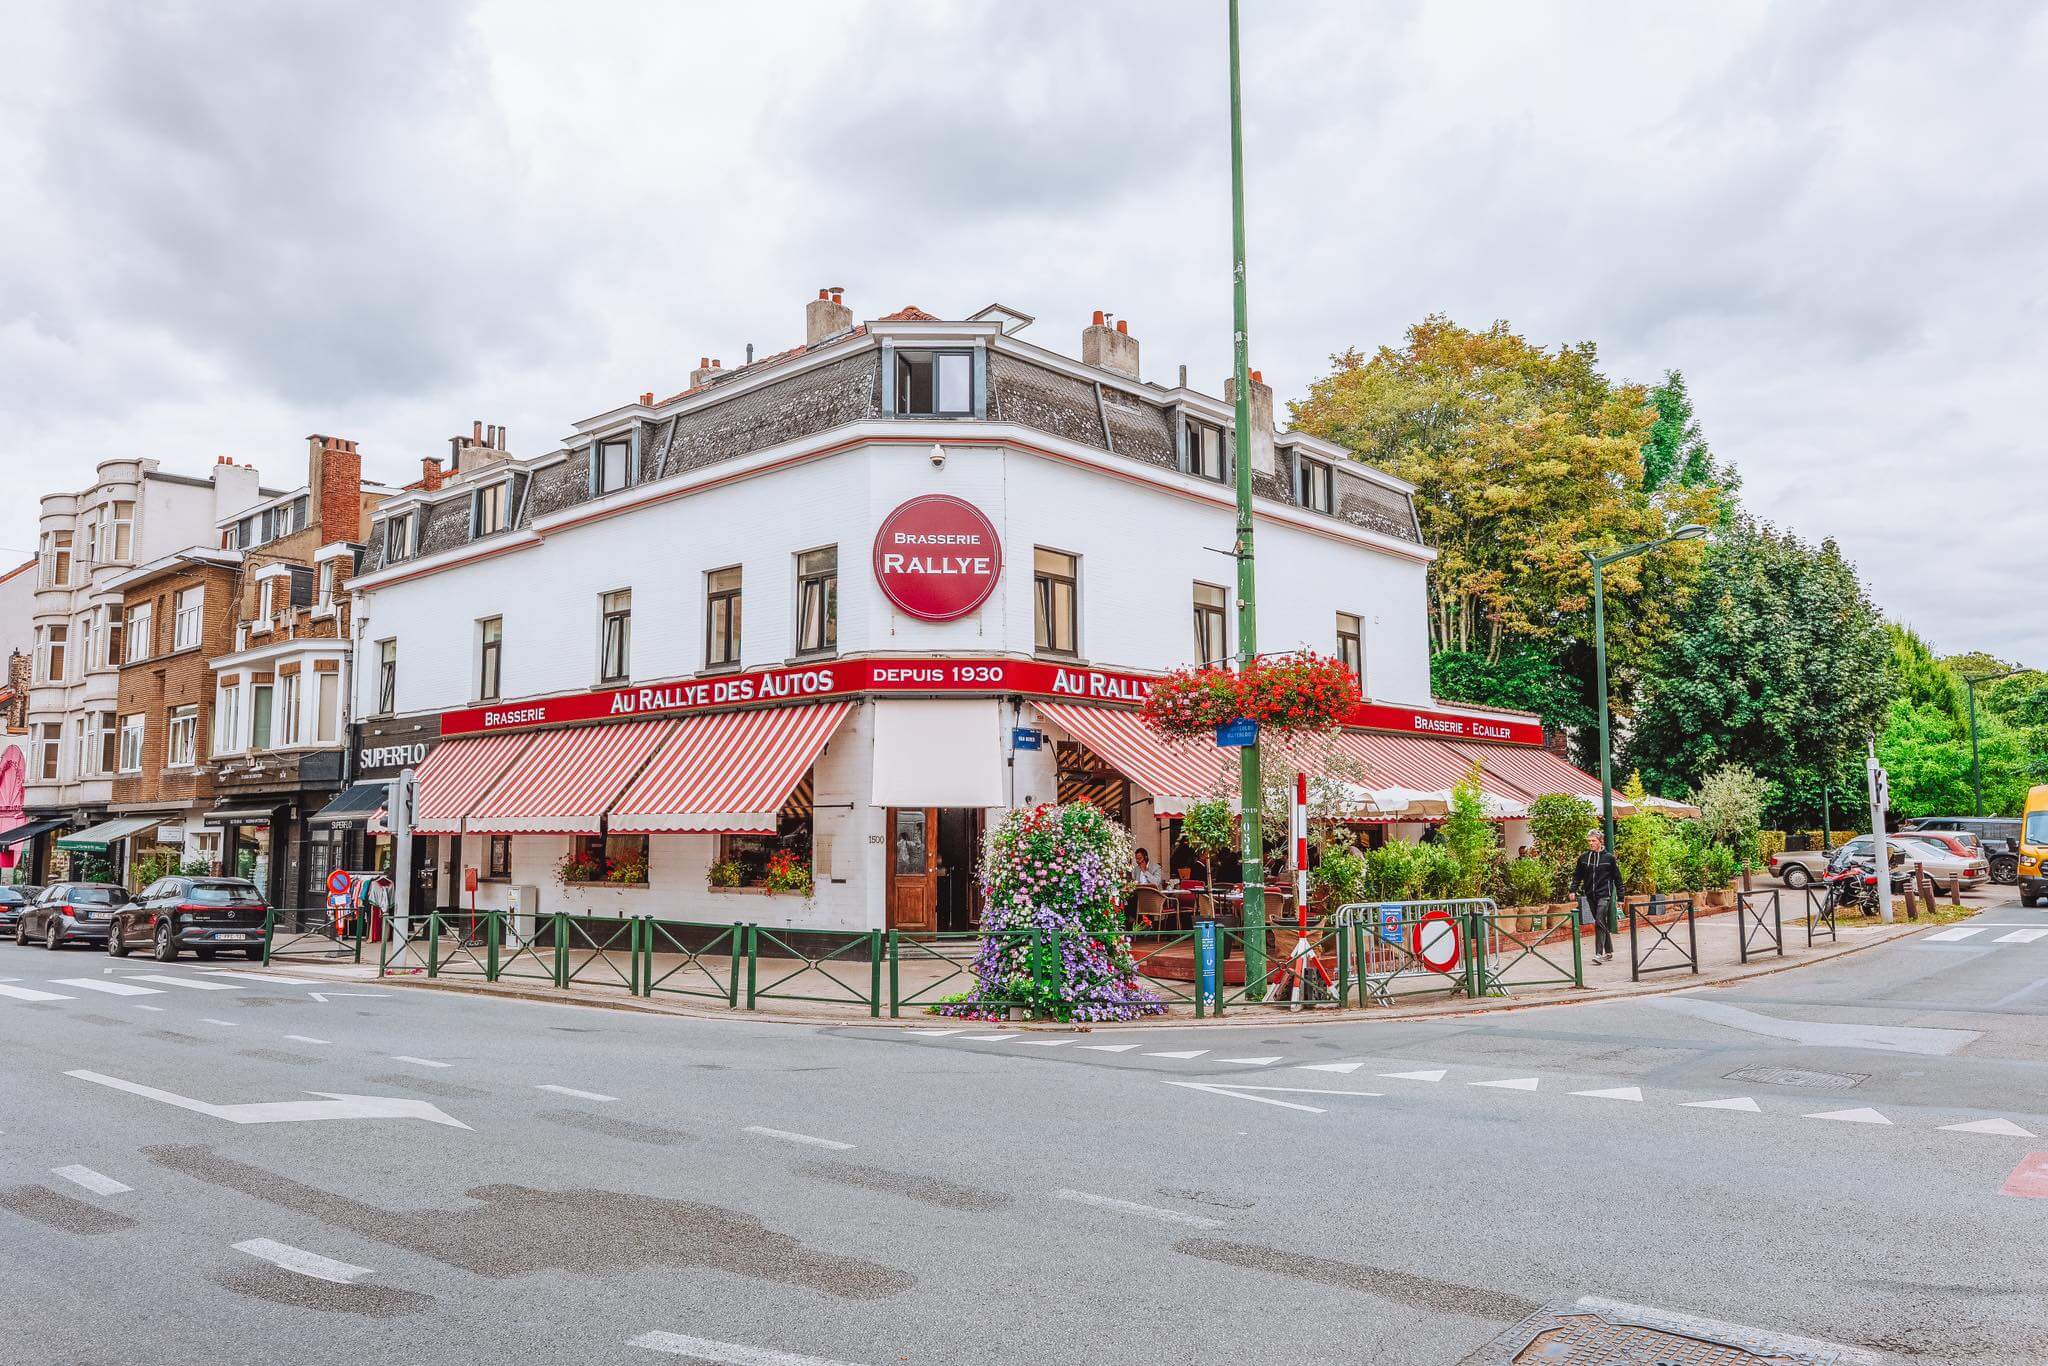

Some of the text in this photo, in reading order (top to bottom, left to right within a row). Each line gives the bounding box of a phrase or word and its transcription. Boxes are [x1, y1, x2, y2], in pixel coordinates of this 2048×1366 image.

[894, 532, 981, 545] BRASSERIE
[883, 553, 991, 574] RALLYE
[873, 666, 1003, 682] DEPUIS 1930
[1051, 668, 1085, 694] AU
[610, 669, 834, 713] AU RALLYE DES AUTOS
[484, 707, 546, 727] BRASSERIE
[1414, 715, 1464, 734] BRASSERIE
[1472, 722, 1511, 739] ECAILLER
[360, 743, 426, 769] SUPERFLO
[869, 835, 885, 845] 1500
